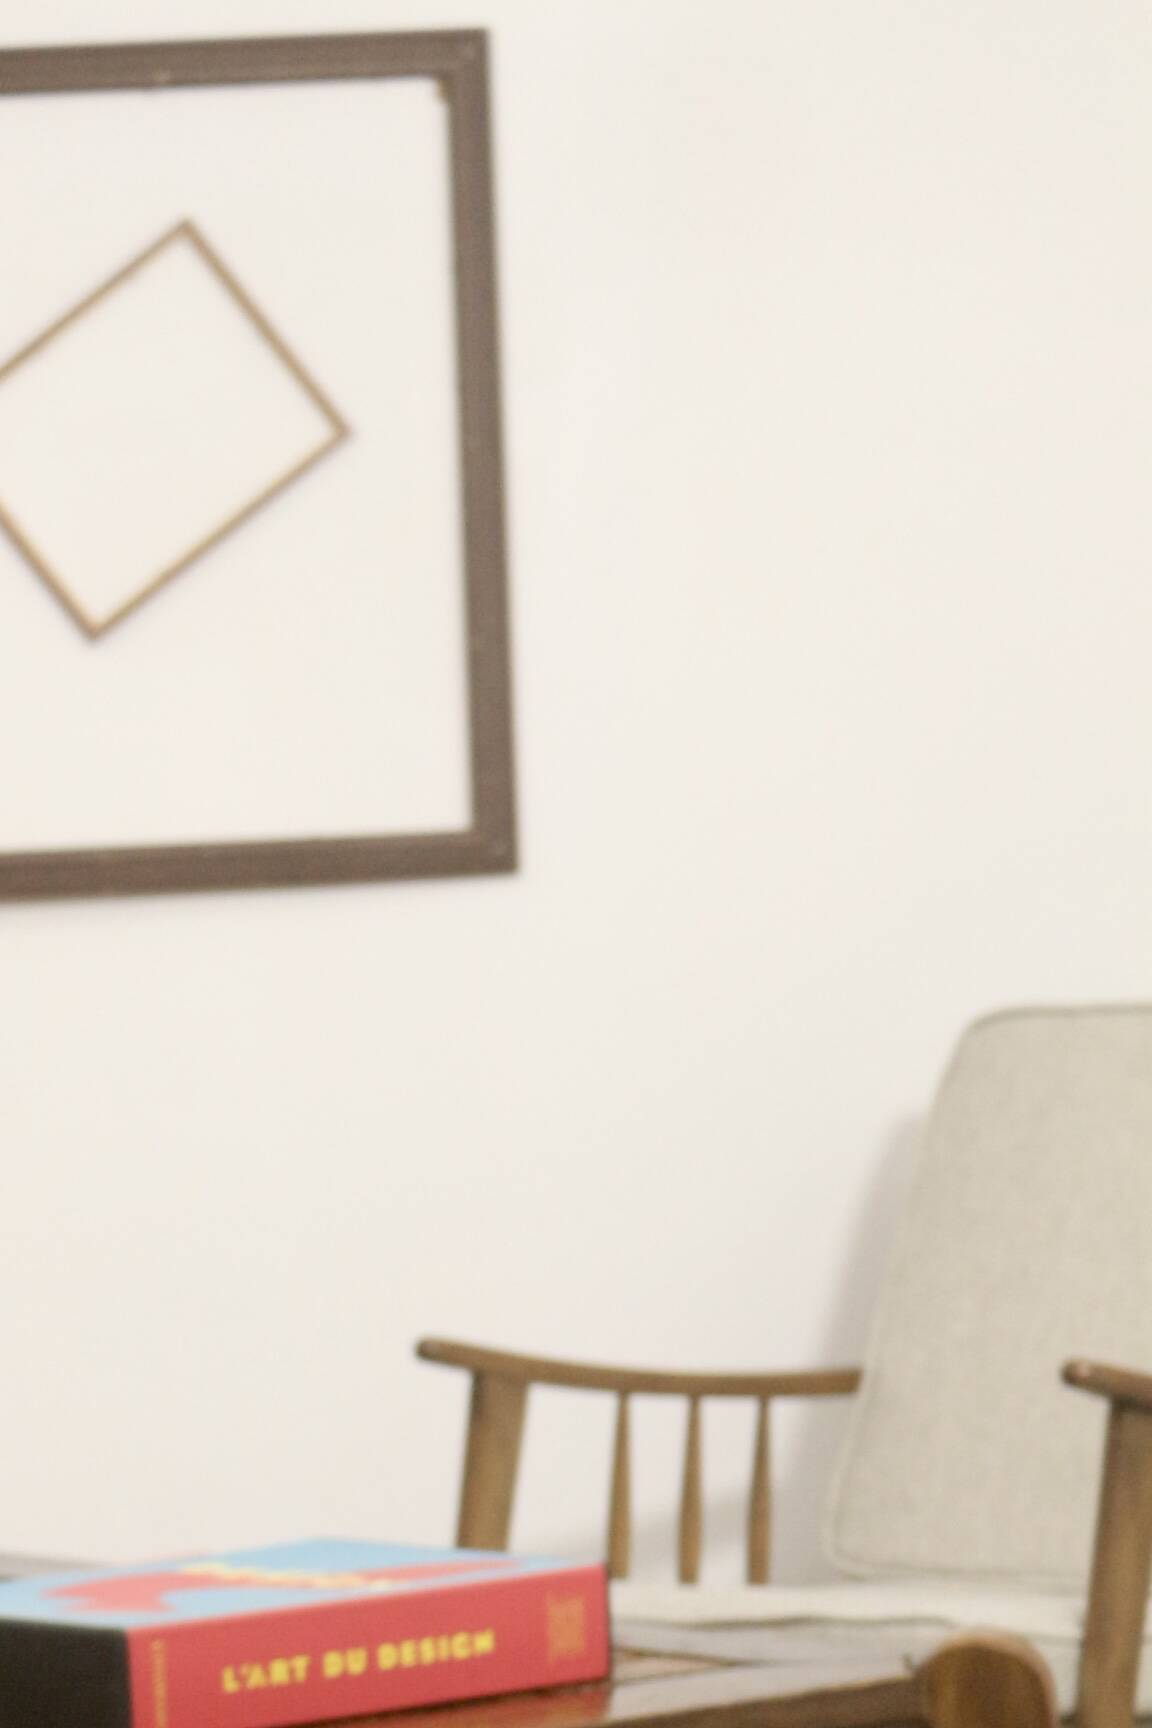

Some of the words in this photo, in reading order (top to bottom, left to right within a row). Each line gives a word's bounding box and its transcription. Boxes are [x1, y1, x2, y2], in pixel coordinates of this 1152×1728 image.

[221, 1654, 309, 1693] L'ART
[322, 1648, 367, 1678] DU
[377, 1629, 495, 1671] DESIGN
